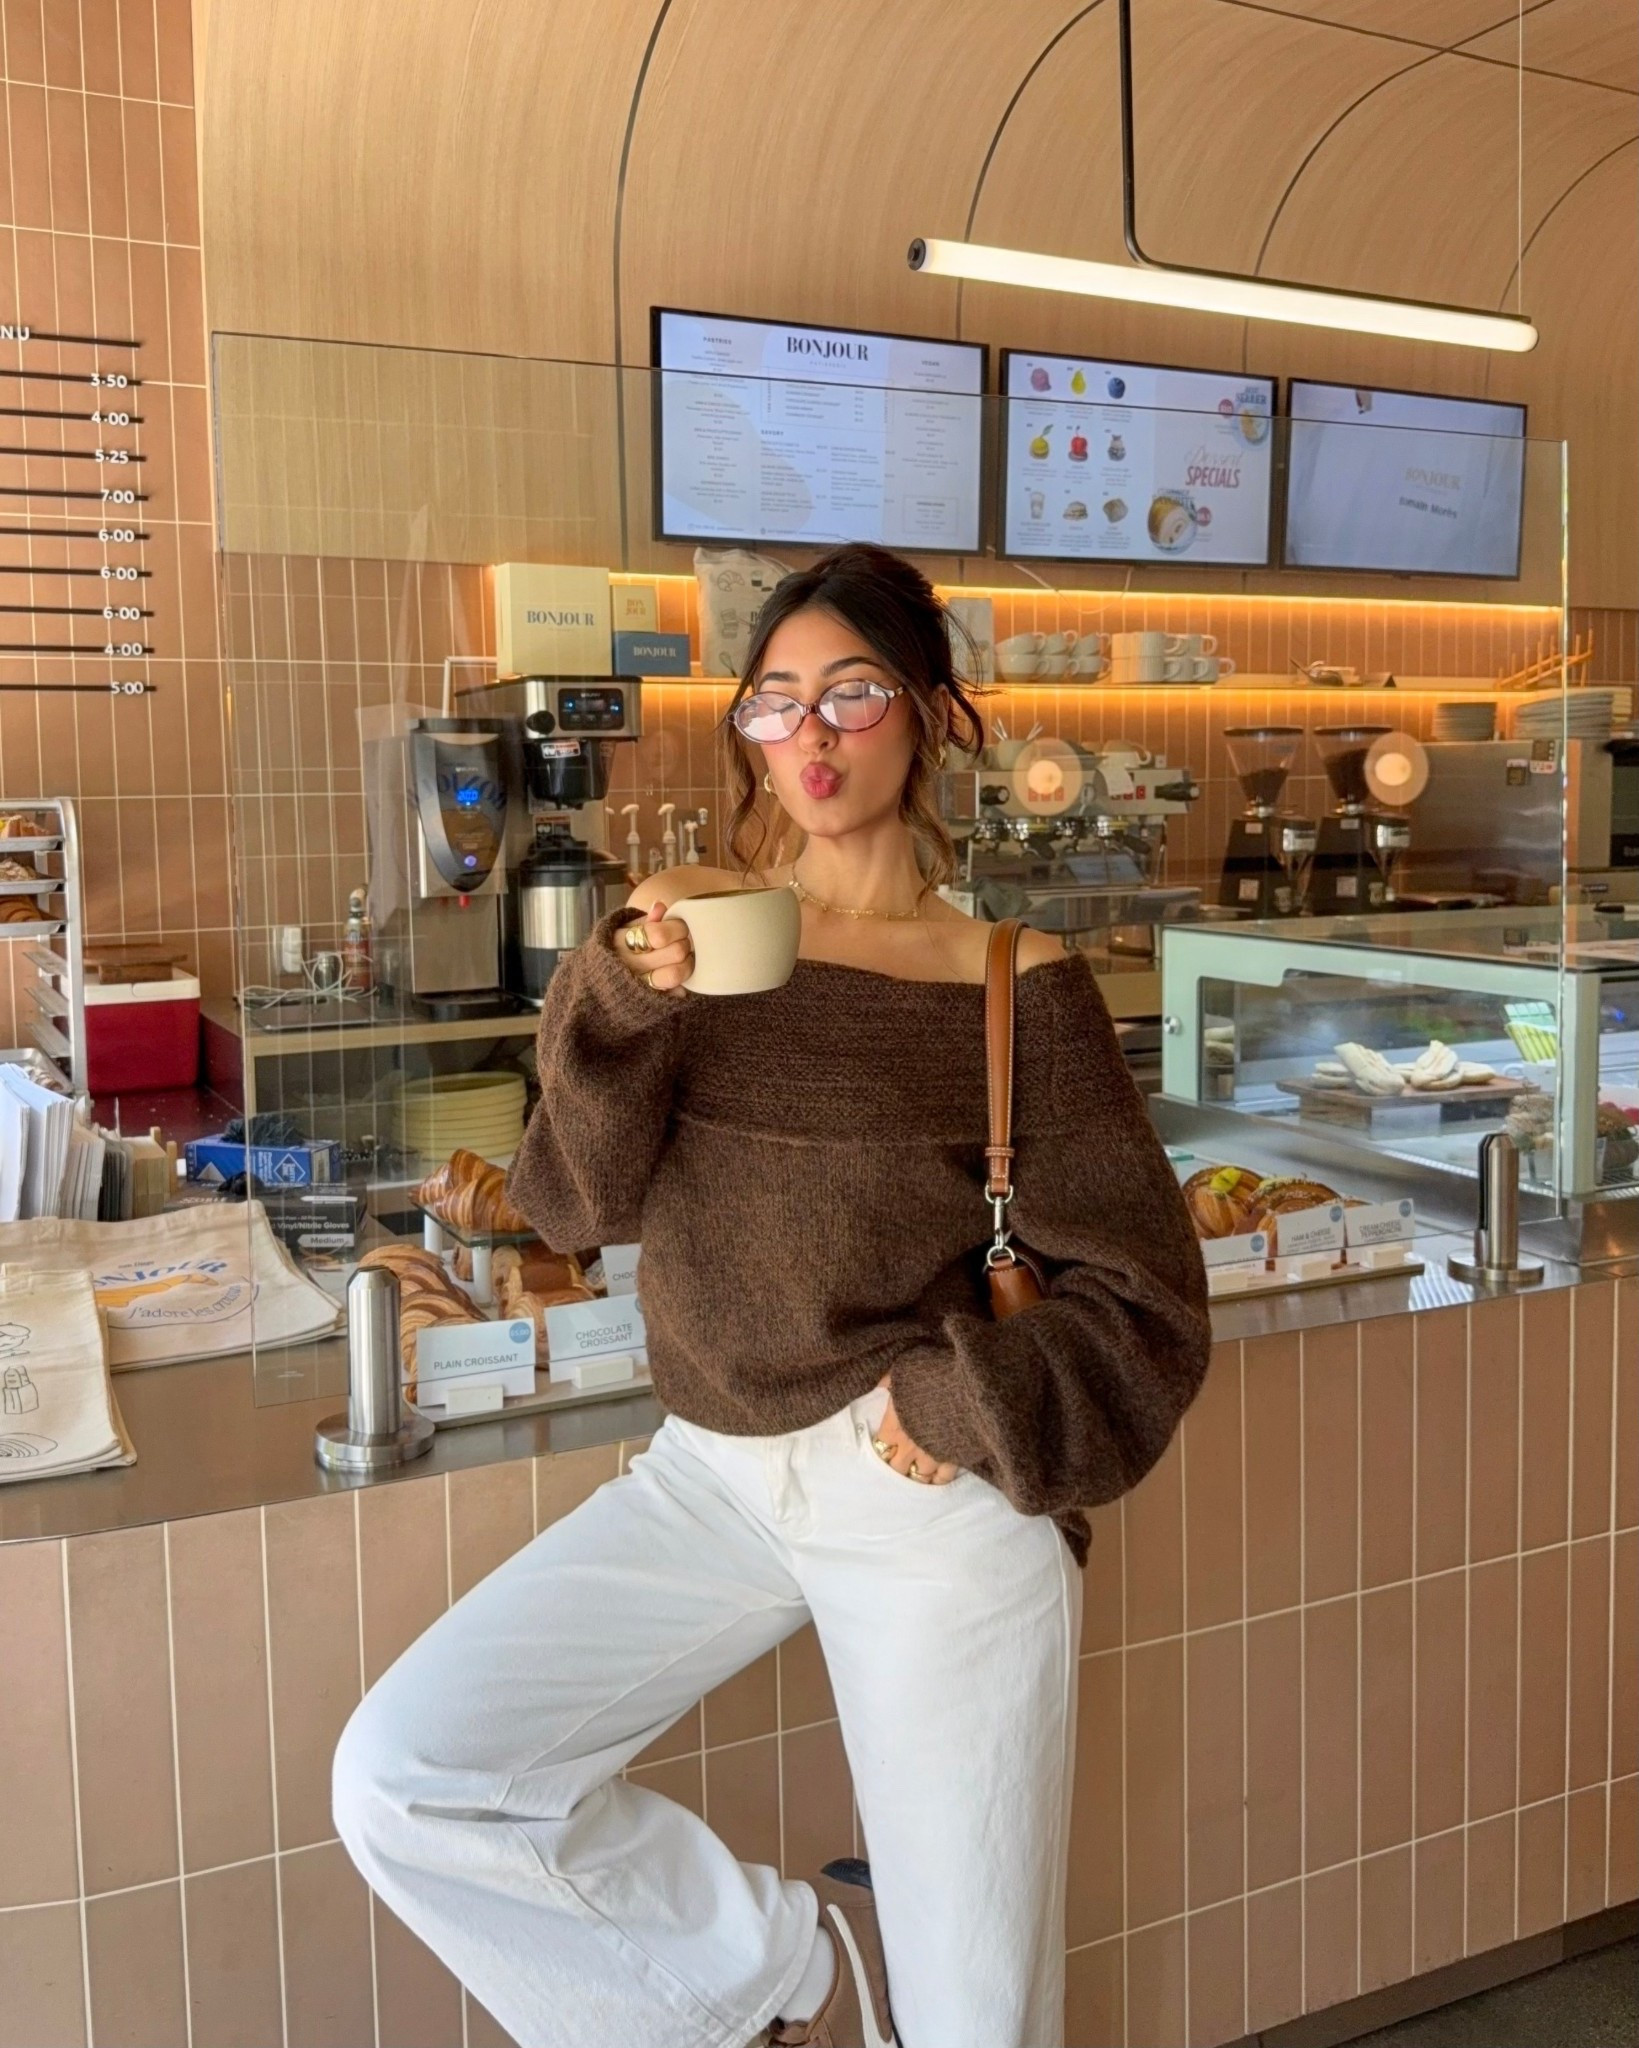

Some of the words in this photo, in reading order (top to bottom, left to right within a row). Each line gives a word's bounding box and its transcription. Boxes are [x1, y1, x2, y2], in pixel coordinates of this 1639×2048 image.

[787, 336, 868, 361] BONJOUR
[1185, 465, 1241, 489] SPECIALS
[527, 611, 595, 627] BONJOUR
[633, 646, 677, 658] BONJOUR
[323, 1221, 350, 1230] Gloves
[311, 1236, 344, 1244] Medium
[575, 1323, 633, 1341] CHOCOLATE
[580, 1331, 633, 1350] CROISSANT
[433, 1360, 463, 1371] PLAIN
[464, 1353, 519, 1367] CROISSANT
